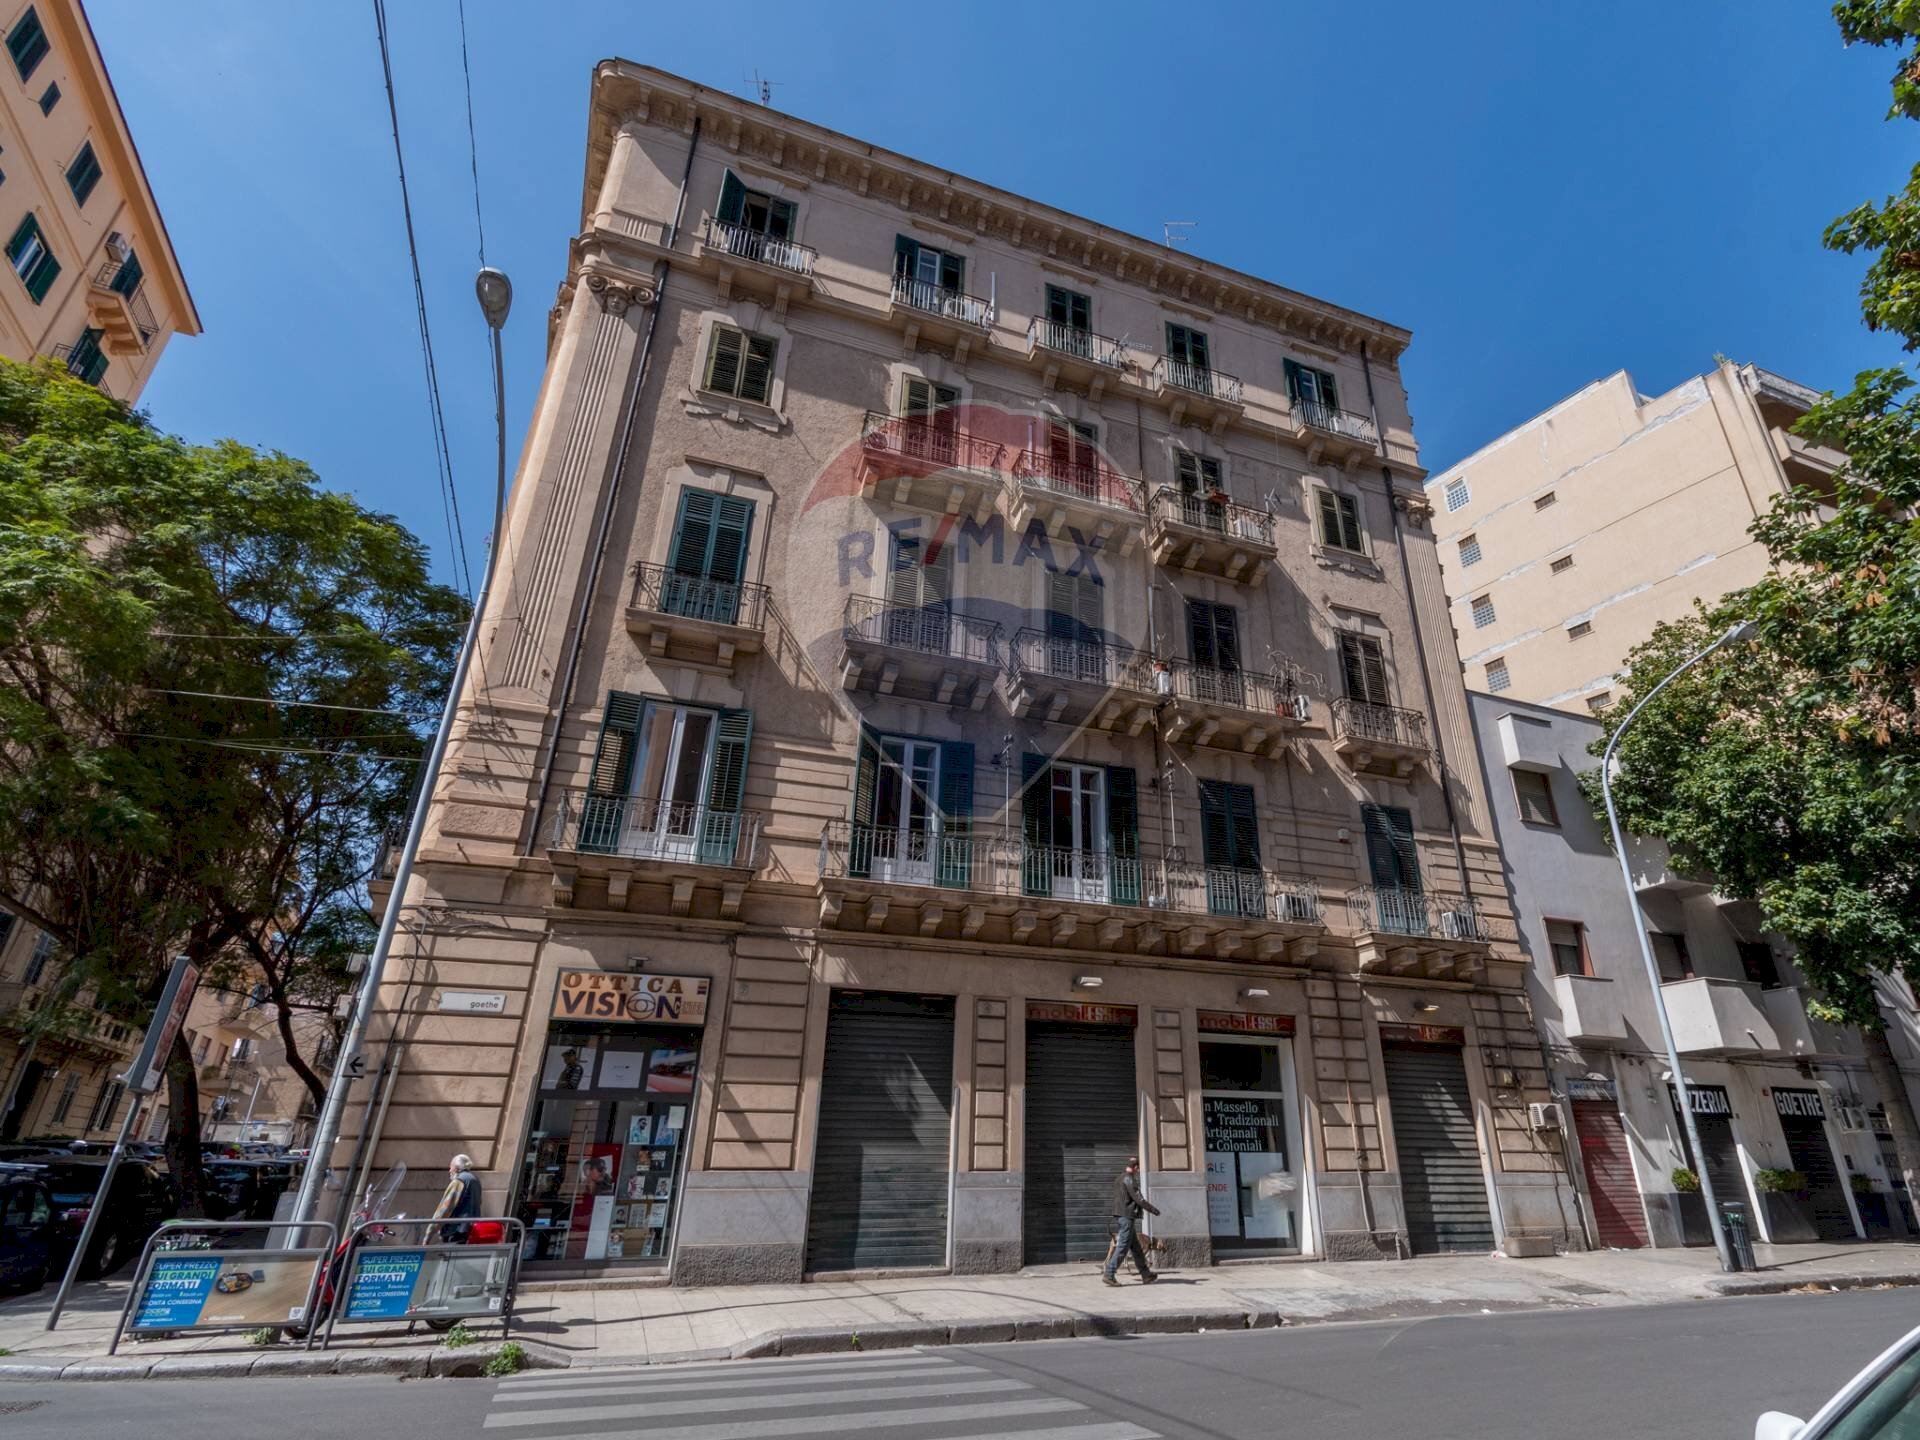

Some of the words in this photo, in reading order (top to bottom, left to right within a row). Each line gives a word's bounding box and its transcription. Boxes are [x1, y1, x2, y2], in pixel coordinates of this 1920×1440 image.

[562, 972, 684, 994] OTTICA
[470, 1001, 499, 1009] goethe
[562, 990, 682, 1020] VISION
[1214, 1100, 1258, 1113] Massello
[1671, 1089, 1730, 1113] PZZERIA
[1774, 1091, 1824, 1116] GOETHE
[1216, 1113, 1279, 1126] Tradizionali
[1216, 1139, 1262, 1152] Coloniali
[183, 1261, 218, 1269] PREZZO
[362, 1256, 388, 1264] SUPER
[389, 1254, 420, 1263] PREZZO
[170, 1270, 214, 1280] GRANDI
[377, 1264, 416, 1273] GRANDI
[357, 1274, 403, 1283] FORMATI
